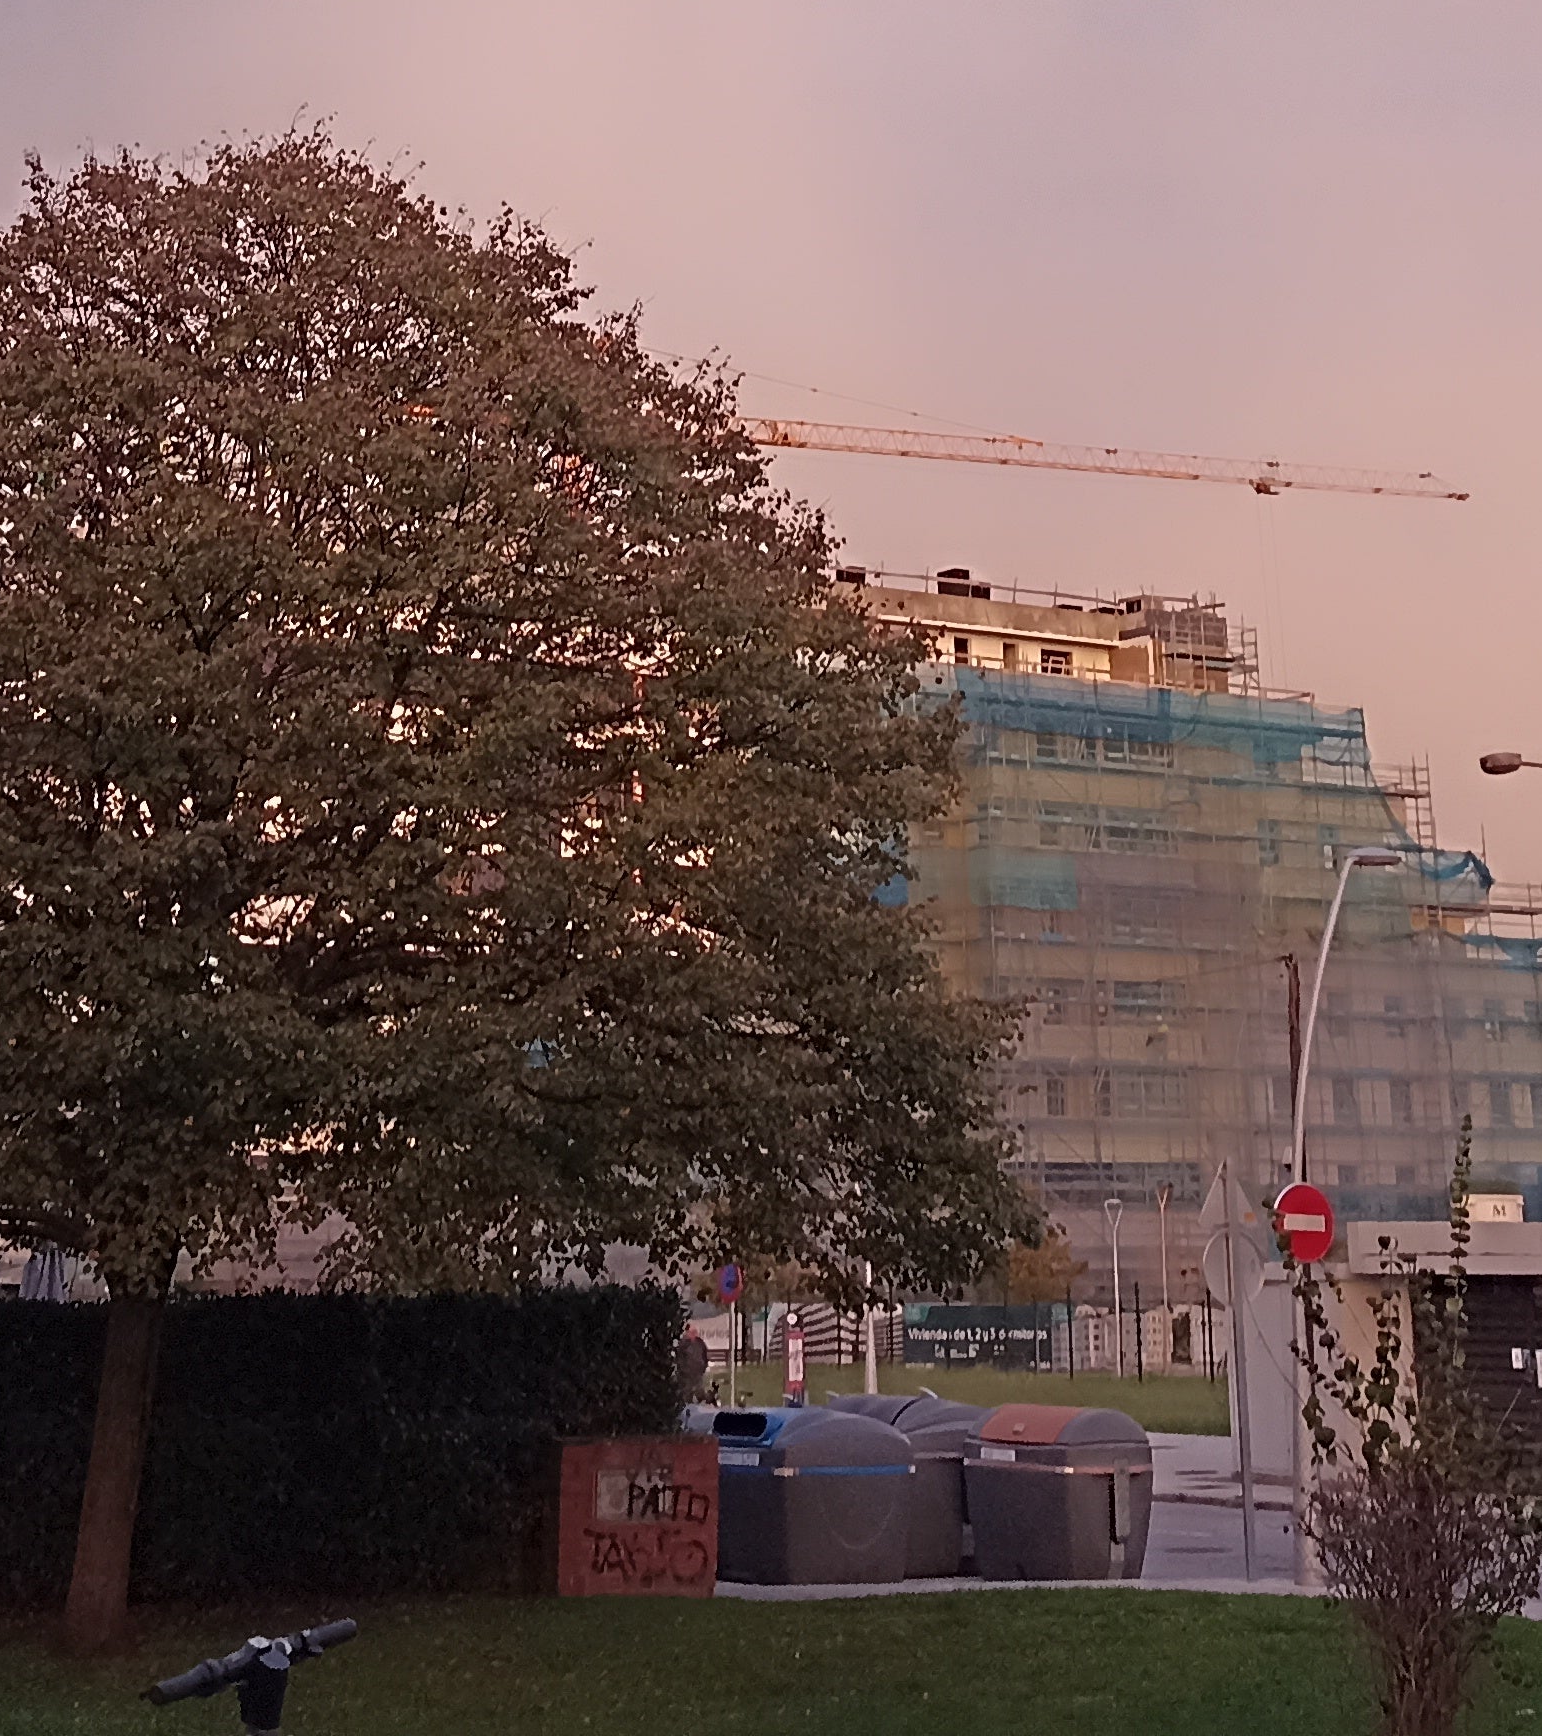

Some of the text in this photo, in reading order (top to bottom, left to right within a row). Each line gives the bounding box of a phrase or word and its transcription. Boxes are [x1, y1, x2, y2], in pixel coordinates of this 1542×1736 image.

[953, 1328, 966, 1340] de
[975, 1327, 982, 1340] 2
[982, 1329, 989, 1343] y
[990, 1327, 996, 1340] 3
